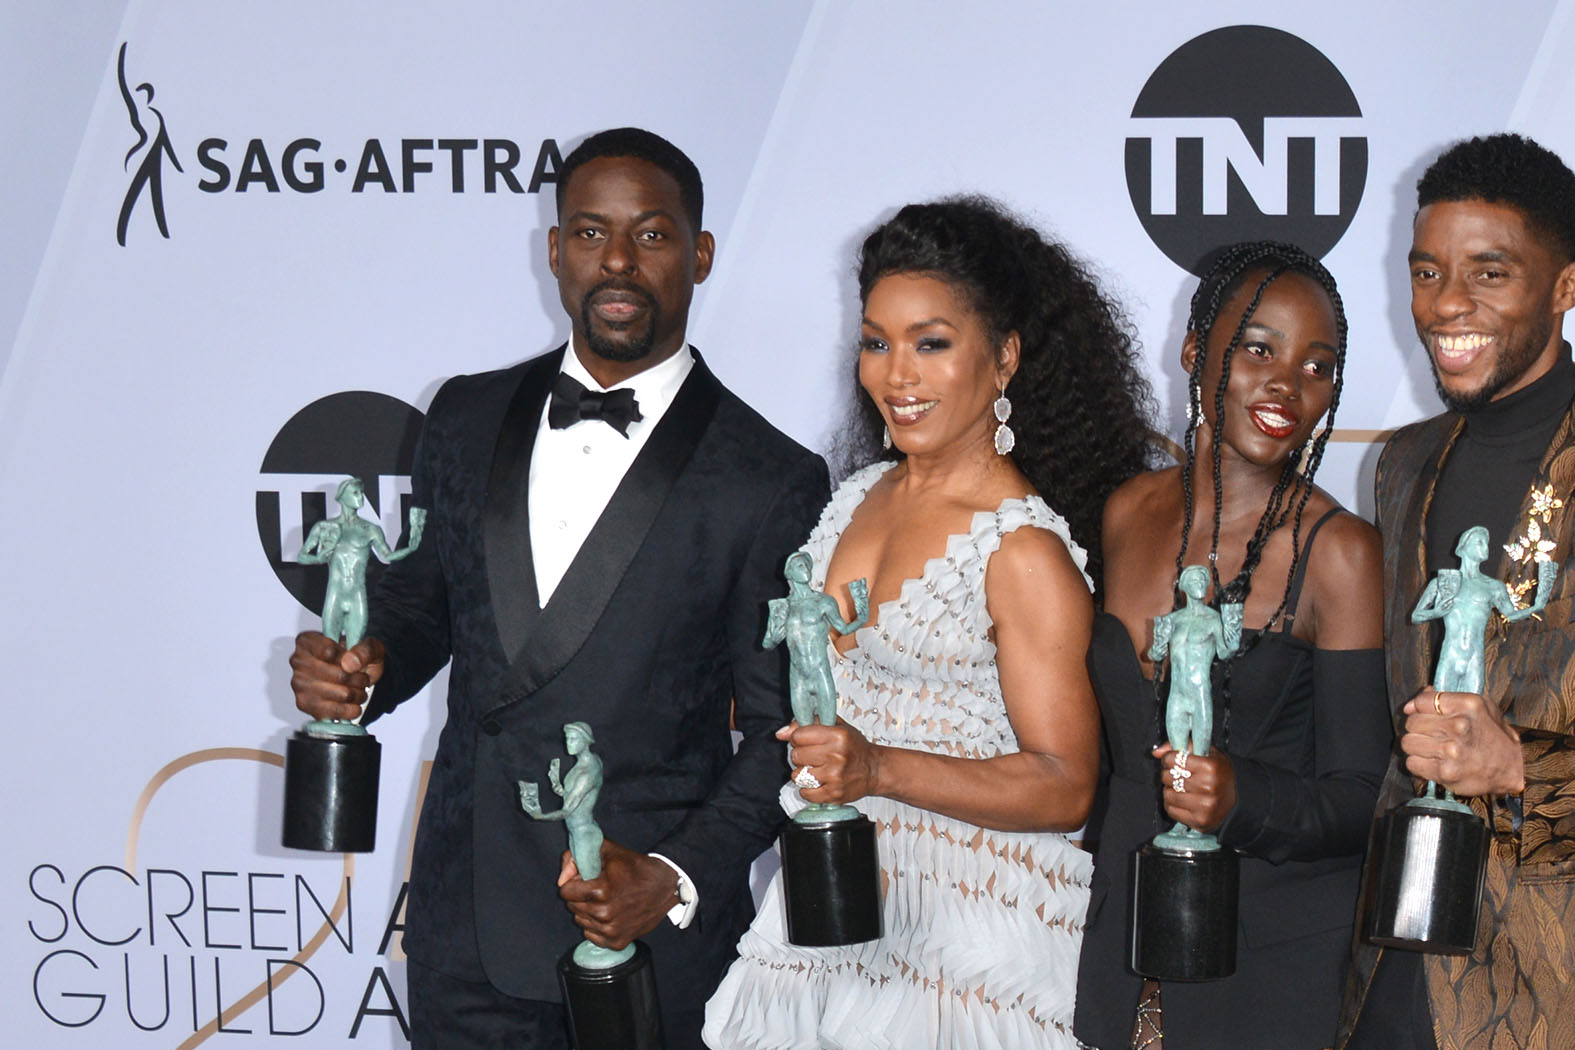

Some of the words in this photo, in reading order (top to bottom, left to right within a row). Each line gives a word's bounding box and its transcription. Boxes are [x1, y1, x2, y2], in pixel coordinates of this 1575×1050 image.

[1129, 116, 1367, 216] TNT
[256, 472, 413, 565] TN
[28, 864, 355, 955] SCREEN
[32, 949, 326, 1037] GUILD
